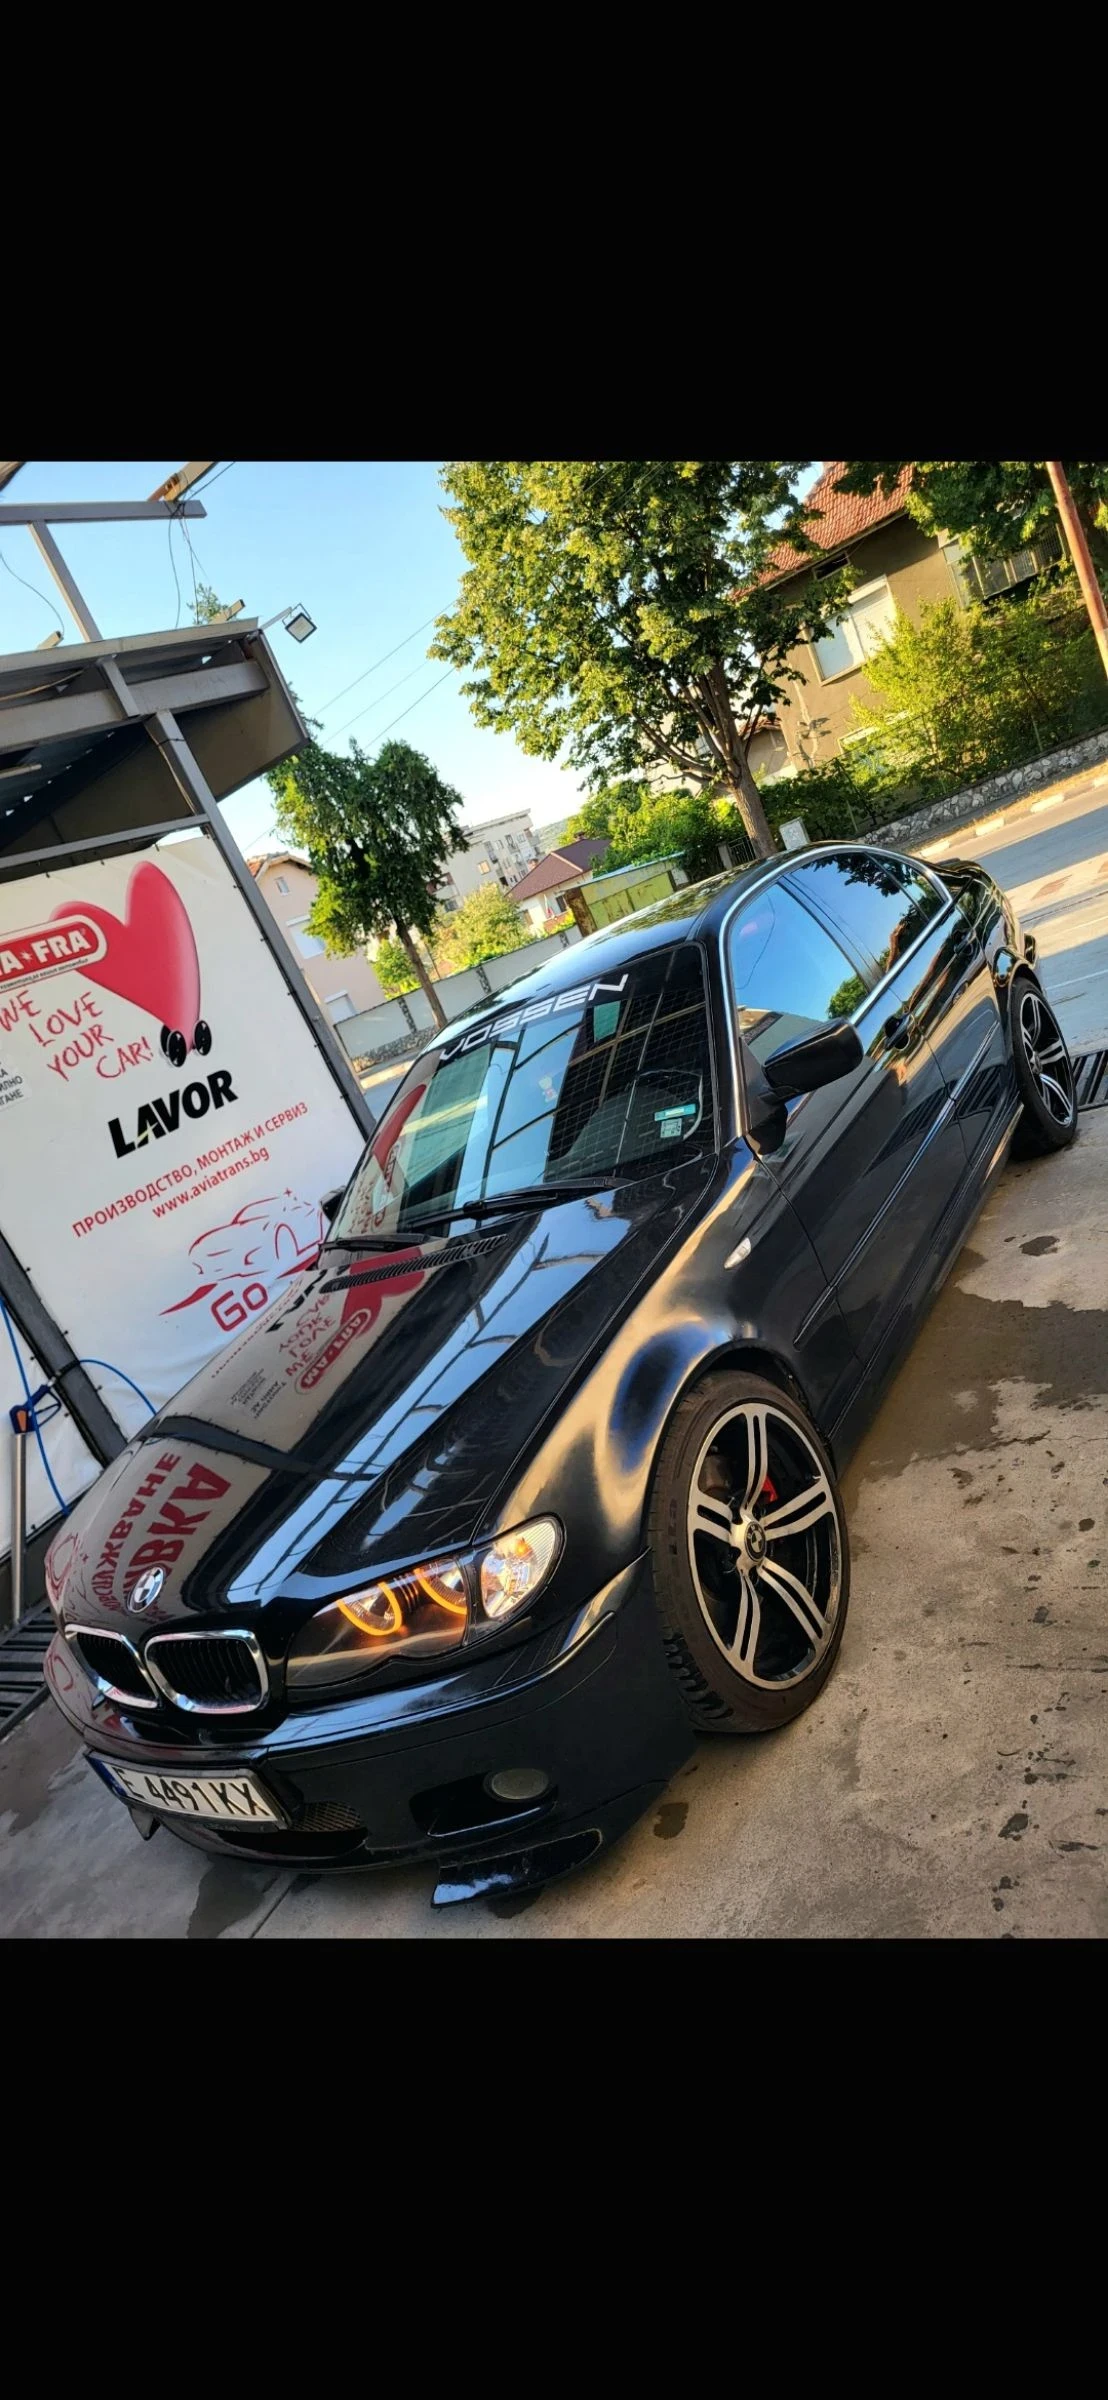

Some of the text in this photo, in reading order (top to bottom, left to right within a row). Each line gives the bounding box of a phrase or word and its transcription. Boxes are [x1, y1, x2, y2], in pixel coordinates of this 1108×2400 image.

[0, 989, 42, 1032] WE
[28, 991, 103, 1047] LOVE
[440, 974, 629, 1061] VOSSEN
[46, 1023, 115, 1081] YOUR
[96, 1036, 154, 1078] CAR!
[108, 1069, 239, 1158] LAVOR
[72, 1101, 309, 1238] ПРОИЗВОДСТВО, МОНТАЖ И СЕРВИЗ
[152, 1146, 270, 1218] www.aviatrans.bg
[112, 1766, 271, 1816] E 4491 KX
